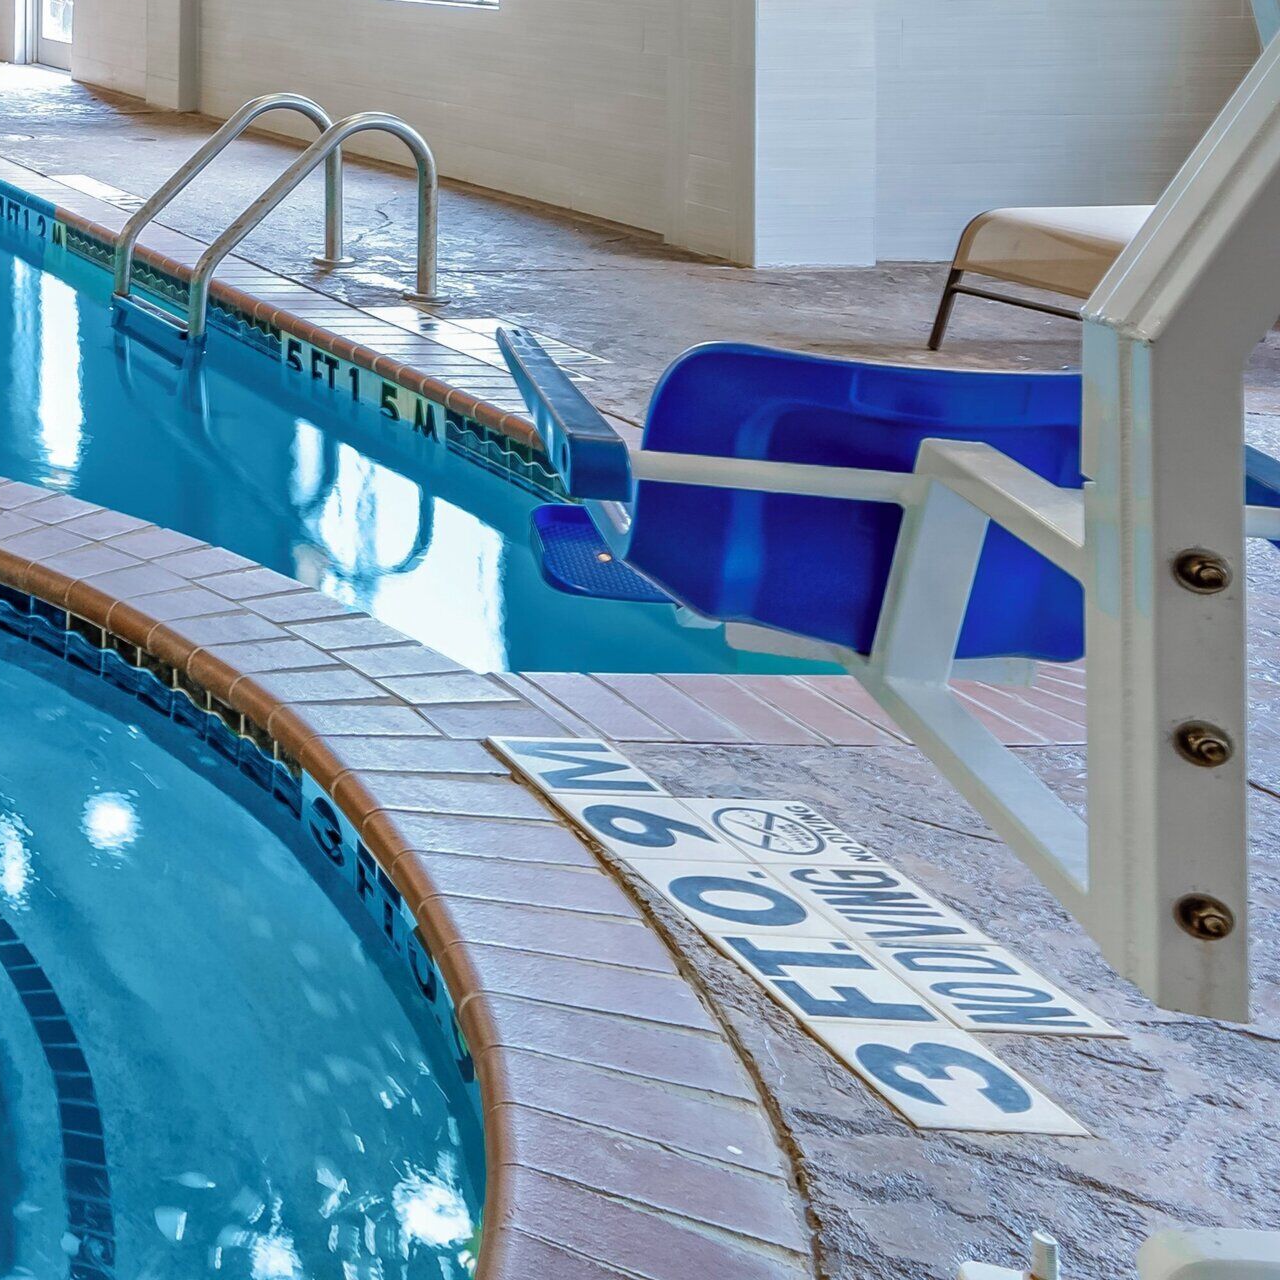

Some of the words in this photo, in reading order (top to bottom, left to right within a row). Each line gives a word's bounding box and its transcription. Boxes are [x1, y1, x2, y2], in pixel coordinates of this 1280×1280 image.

[7, 200, 21, 225] FT
[52, 222, 63, 248] M
[286, 337, 303, 372] 5
[311, 348, 340, 389] FT
[413, 398, 440, 444] M
[501, 742, 661, 793] M
[785, 805, 856, 844] DIVING
[840, 846, 880, 863] NO
[790, 868, 1022, 976] DIVING
[929, 982, 1094, 1028] NO
[854, 1041, 1033, 1115] 3
